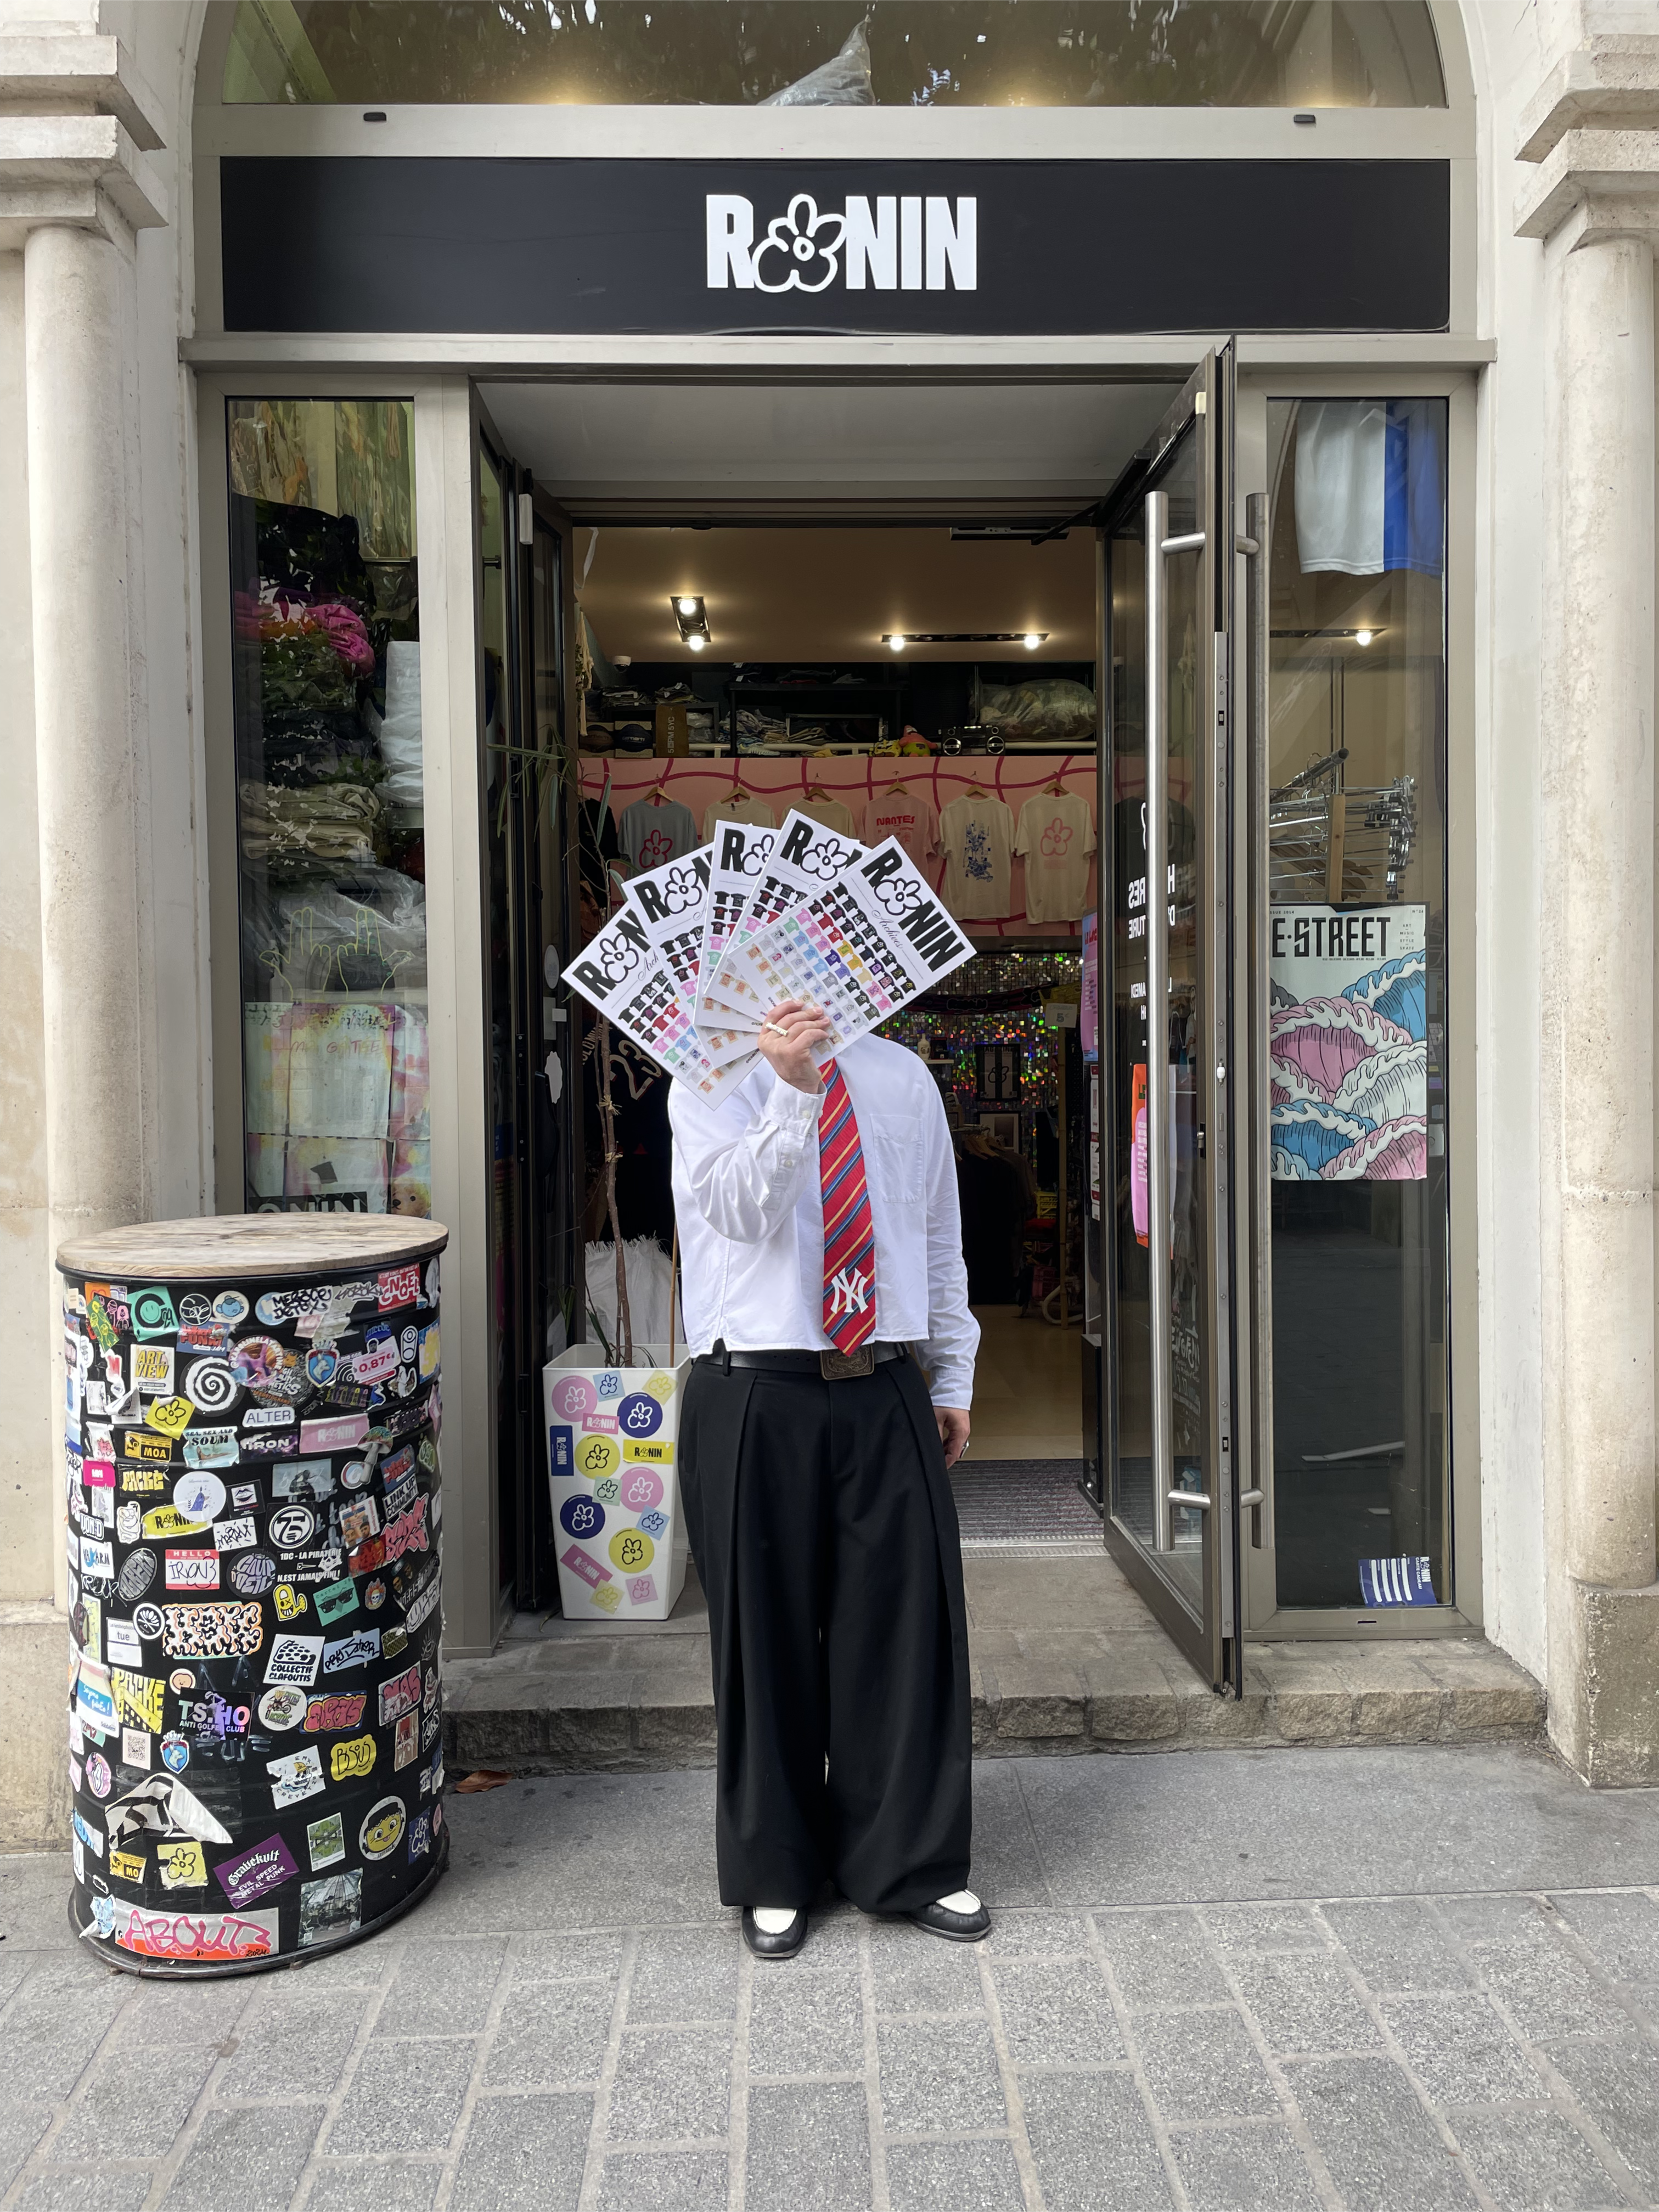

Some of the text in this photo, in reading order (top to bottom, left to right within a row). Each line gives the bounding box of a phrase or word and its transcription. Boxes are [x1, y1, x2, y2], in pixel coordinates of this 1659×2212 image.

[876, 815, 915, 826] NANTES
[871, 910, 903, 949] Archives
[830, 1267, 868, 1314] NY
[136, 1364, 169, 1379] VIEW
[144, 1447, 166, 1459] MOA
[406, 1477, 415, 1493] UP
[280, 1552, 294, 1561] 1DC
[308, 1549, 342, 1558] PIRATERIE
[297, 1572, 322, 1581] JAMAIS
[117, 1631, 130, 1641] tue
[271, 1663, 313, 1674] COLLECTIF
[269, 1672, 311, 1682] CLAFOUTIS
[179, 1720, 196, 1729] ANTI
[256, 1864, 277, 1881] SPEED
[239, 1865, 286, 1898] METAL PUNK
[124, 1909, 273, 1956] ABOUT
